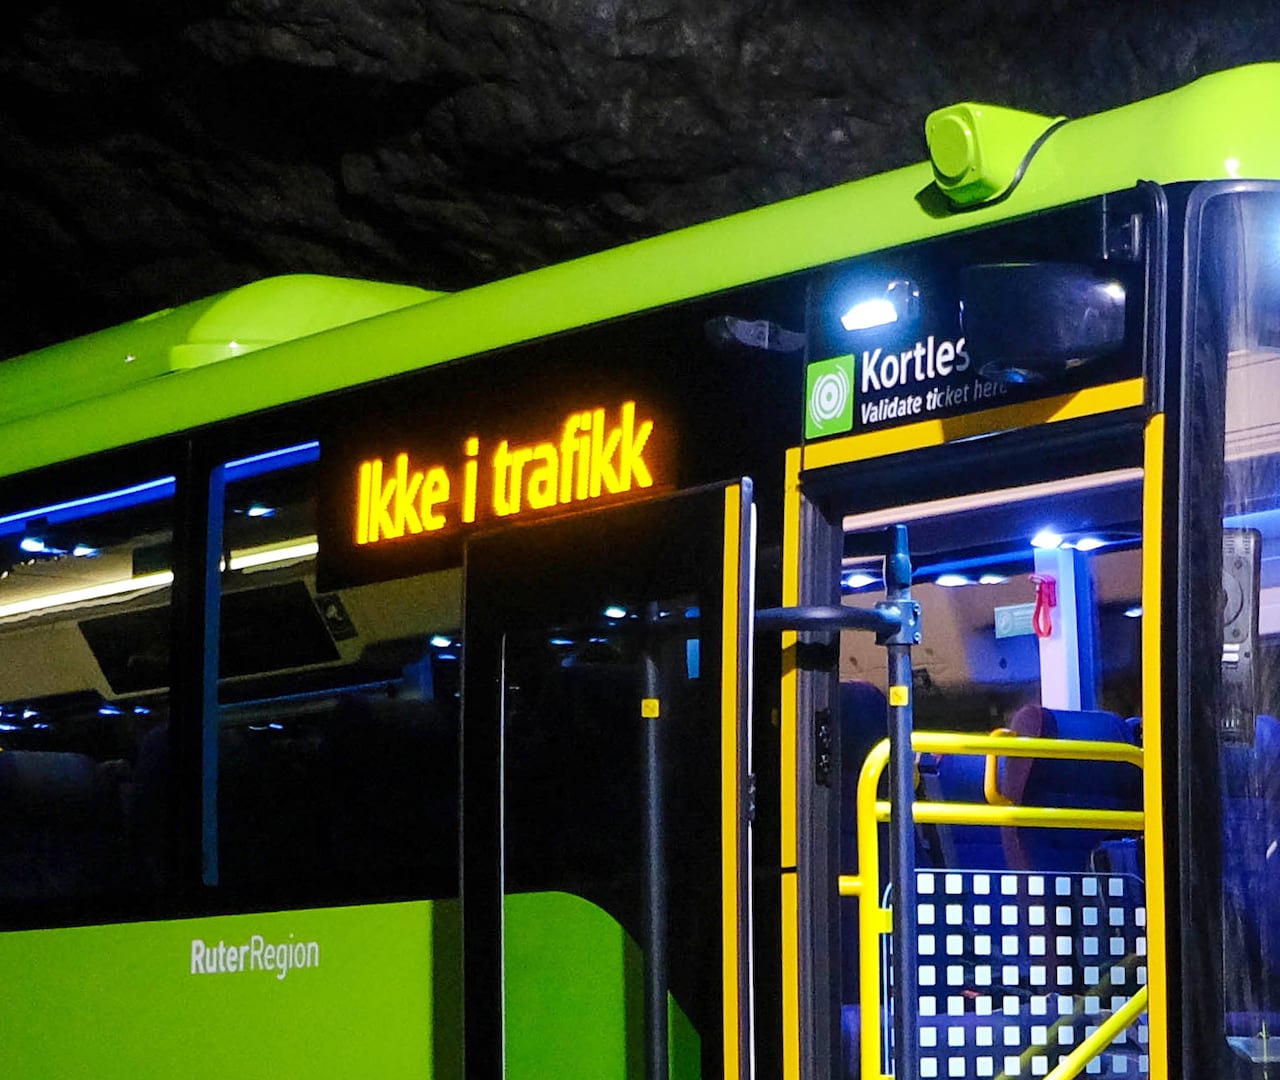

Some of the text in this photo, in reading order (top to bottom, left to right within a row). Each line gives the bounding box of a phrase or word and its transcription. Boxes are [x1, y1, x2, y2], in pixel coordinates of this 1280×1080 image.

[861, 394, 922, 424] Validate
[926, 386, 970, 411] ticket
[356, 401, 654, 544] Ikke i trafikk
[191, 933, 319, 980] RuterRegion
